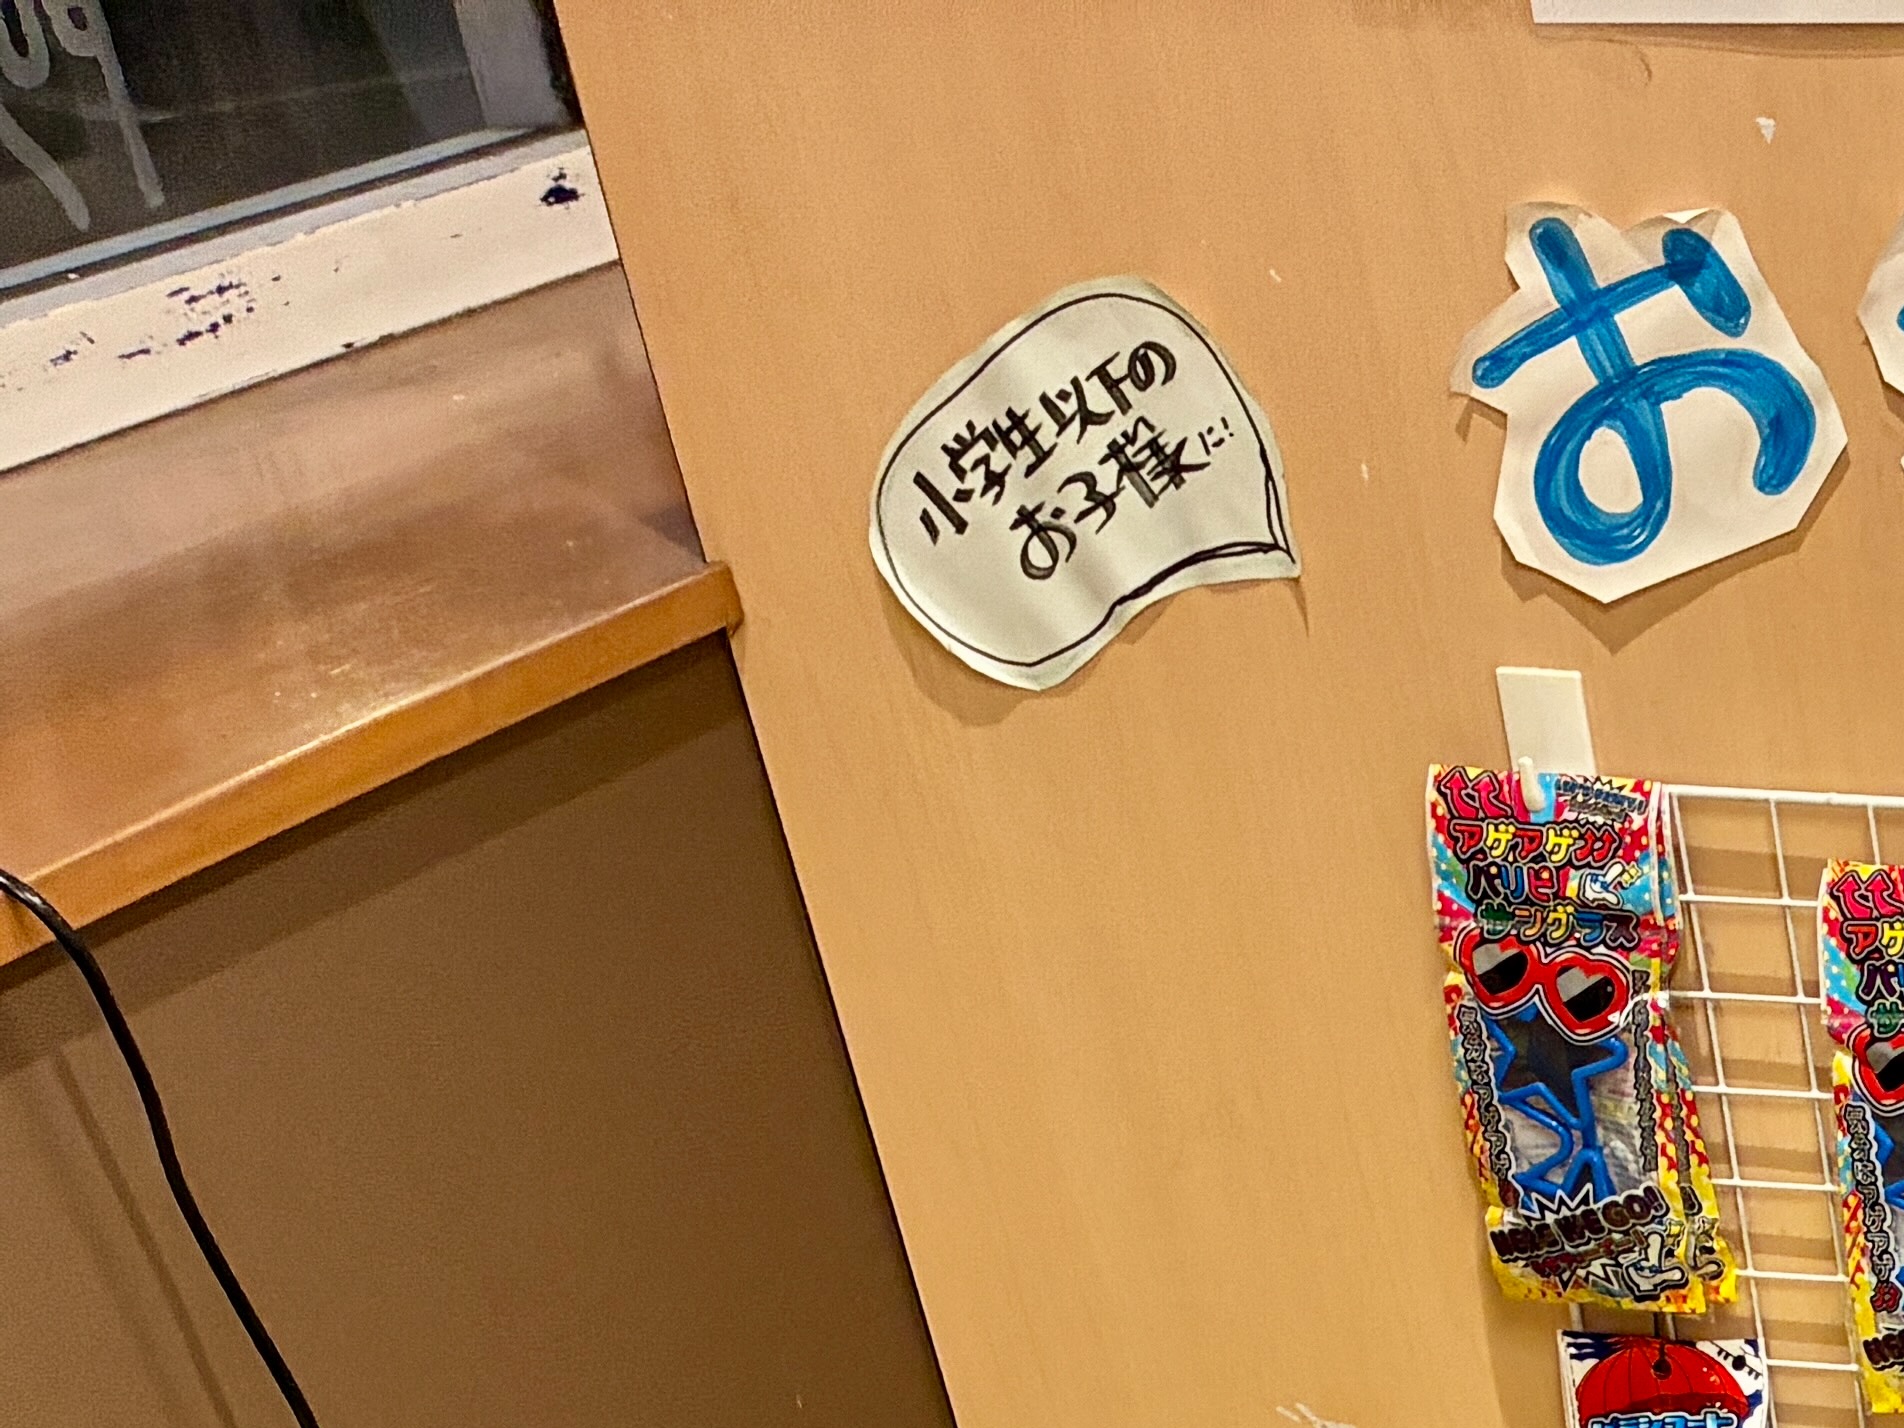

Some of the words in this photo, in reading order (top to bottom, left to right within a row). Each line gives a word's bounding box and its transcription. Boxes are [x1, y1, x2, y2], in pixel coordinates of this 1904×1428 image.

[918, 340, 1179, 546] 小学生以下の
[1452, 822, 1578, 861] アゲアゲ
[1470, 863, 1554, 900] パリピ
[1479, 904, 1639, 946] サングラス
